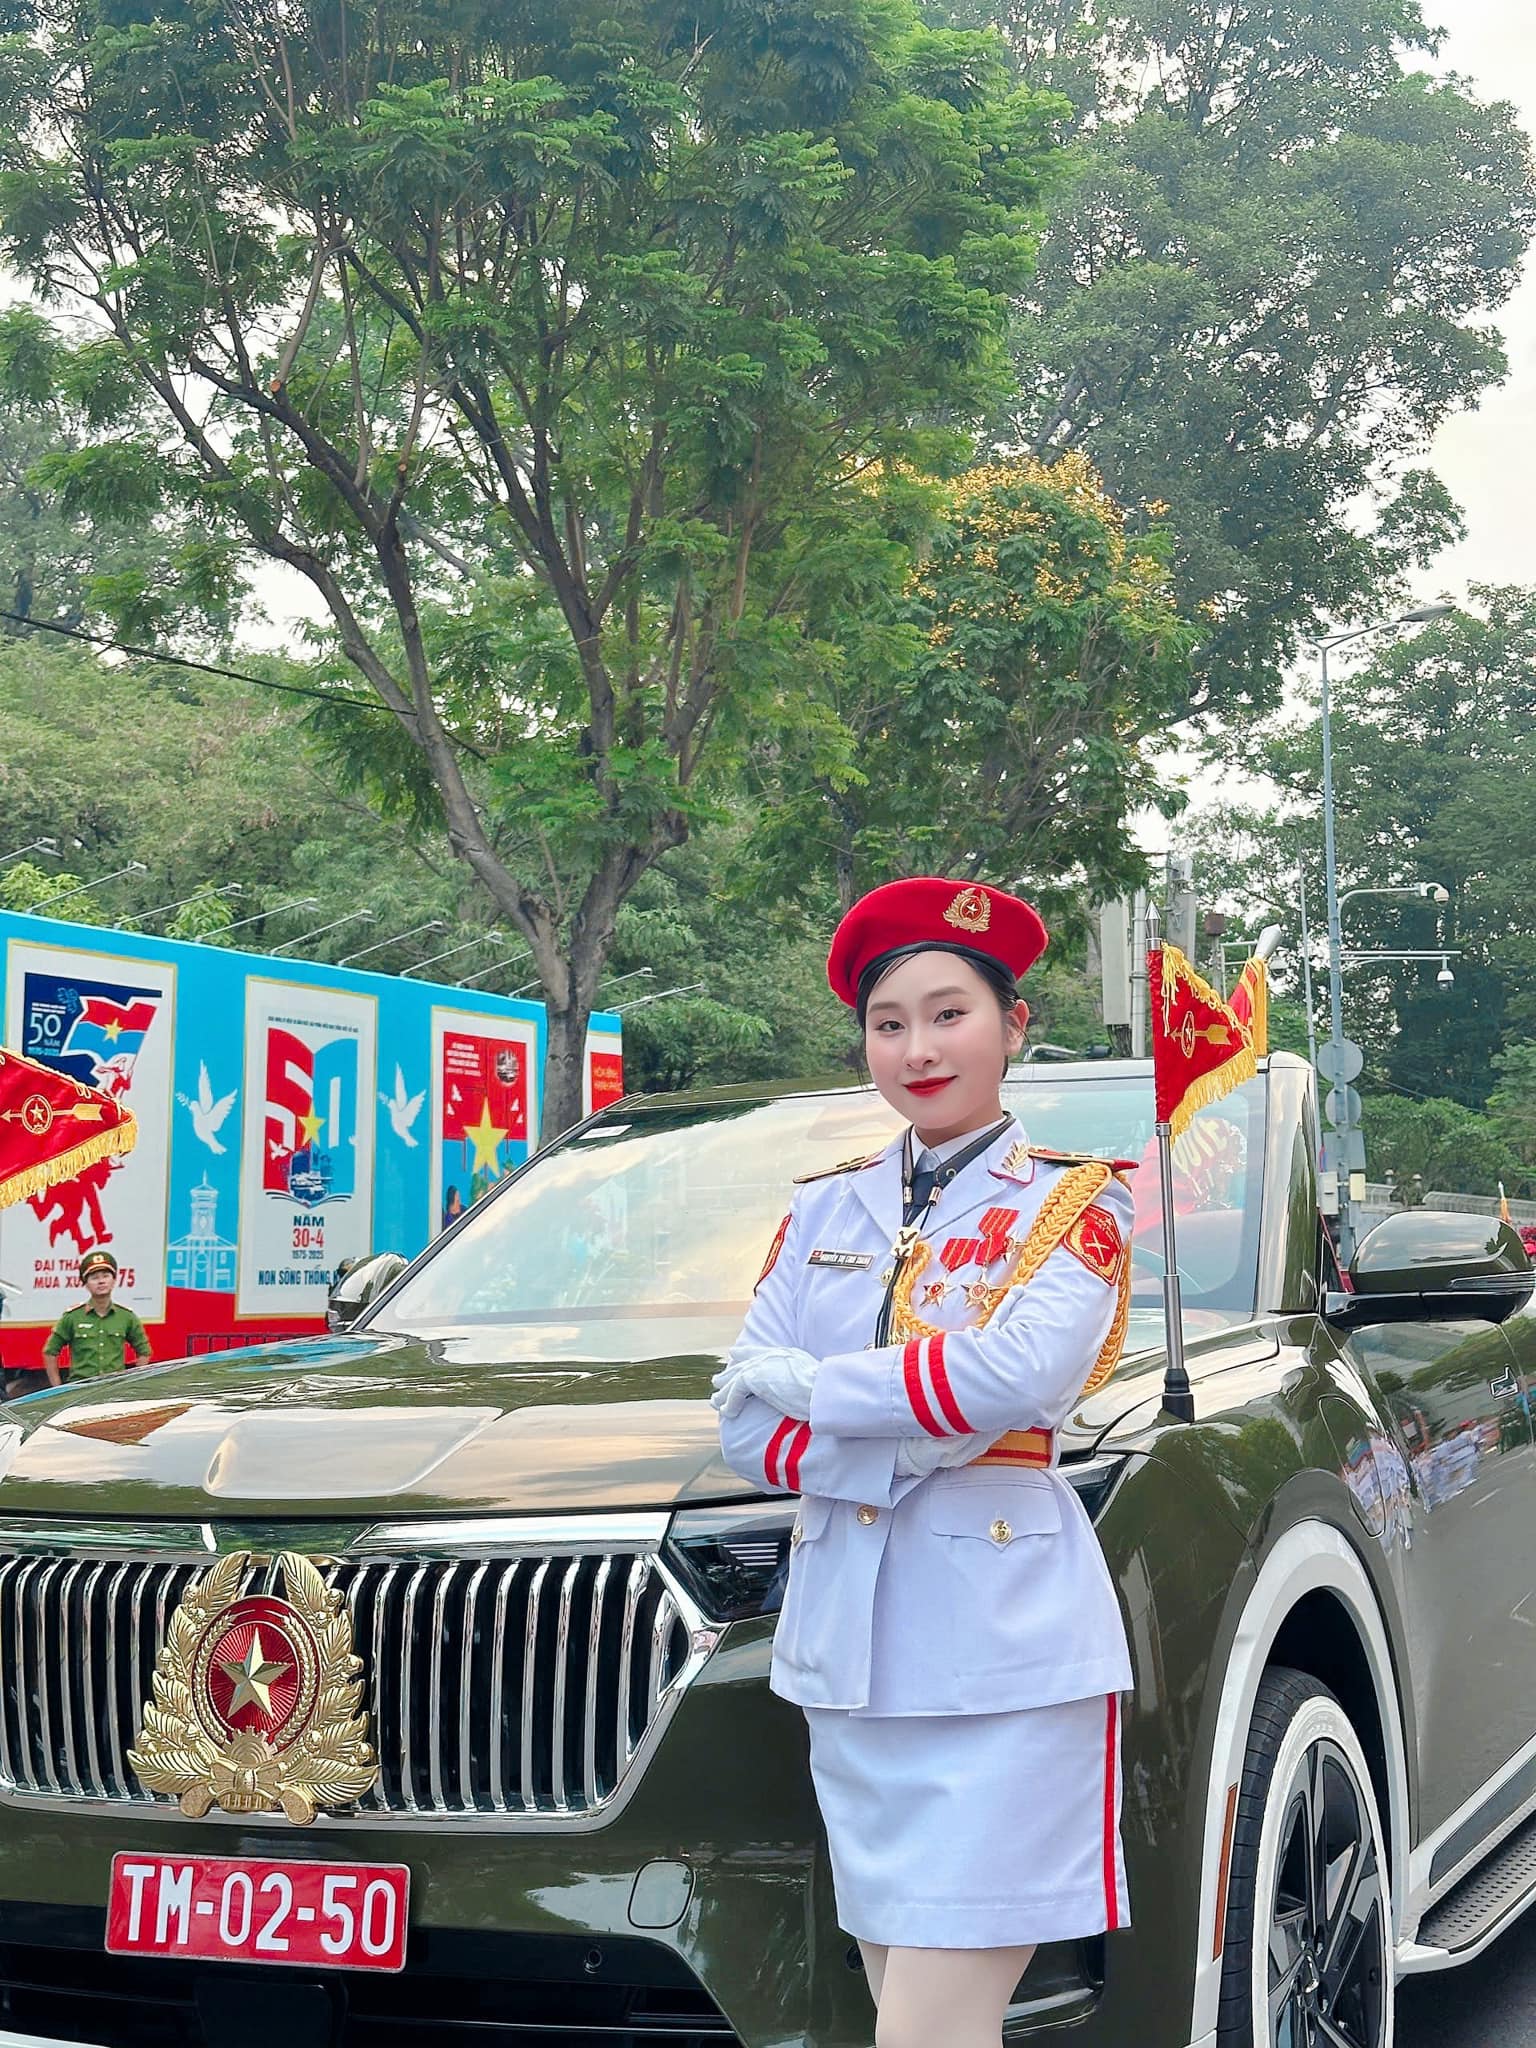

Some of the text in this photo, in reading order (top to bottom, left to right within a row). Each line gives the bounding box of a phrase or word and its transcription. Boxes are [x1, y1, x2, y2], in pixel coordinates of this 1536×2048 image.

[28, 1012, 61, 1045] 50
[293, 1213, 325, 1227] NĂM
[292, 1228, 324, 1248] 30-4
[258, 1269, 276, 1285] NON
[279, 1266, 300, 1285] SÔNG
[304, 1264, 330, 1285] THỐNG
[122, 1863, 396, 1955] TM-02-50
